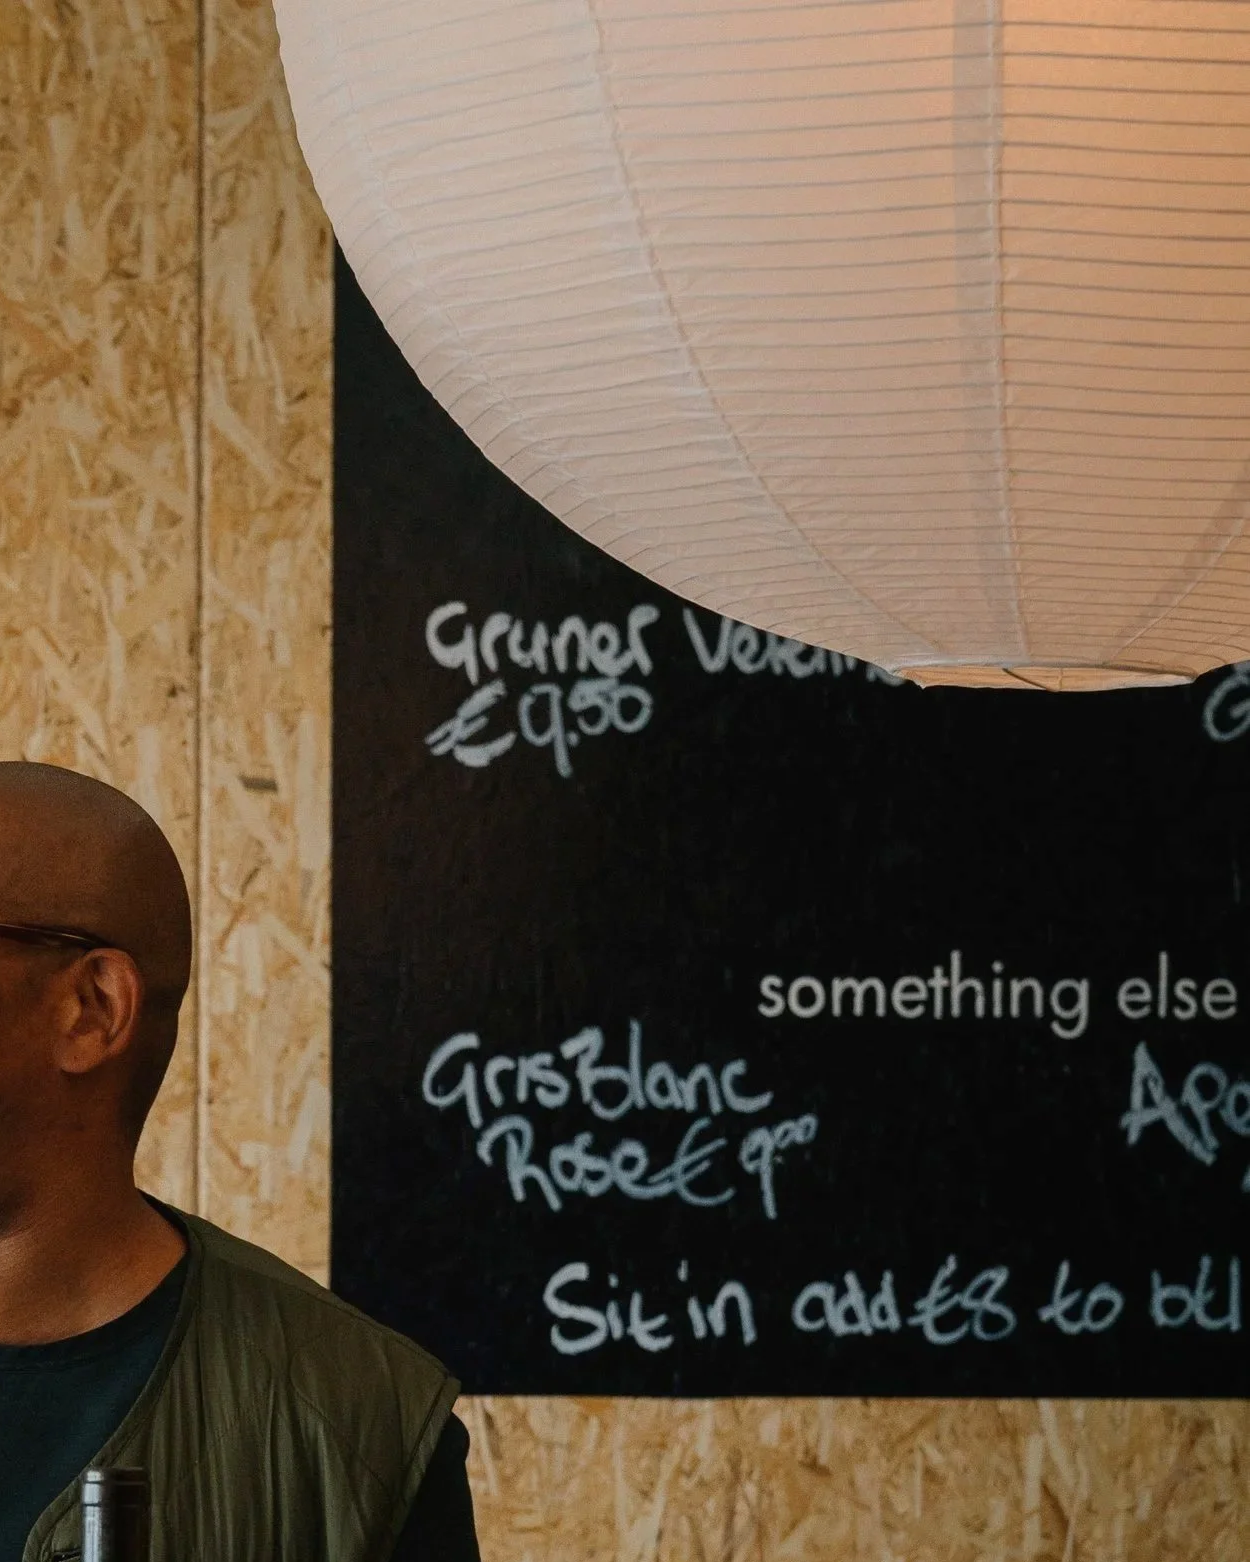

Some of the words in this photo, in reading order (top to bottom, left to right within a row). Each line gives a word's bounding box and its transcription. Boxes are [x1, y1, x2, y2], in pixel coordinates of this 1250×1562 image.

[758, 952, 1089, 1040] something
[1117, 951, 1238, 1020] else
[542, 1261, 674, 1356] Sit
[677, 1260, 757, 1345] in
[792, 1270, 902, 1337] add
[1038, 1259, 1124, 1334] to
